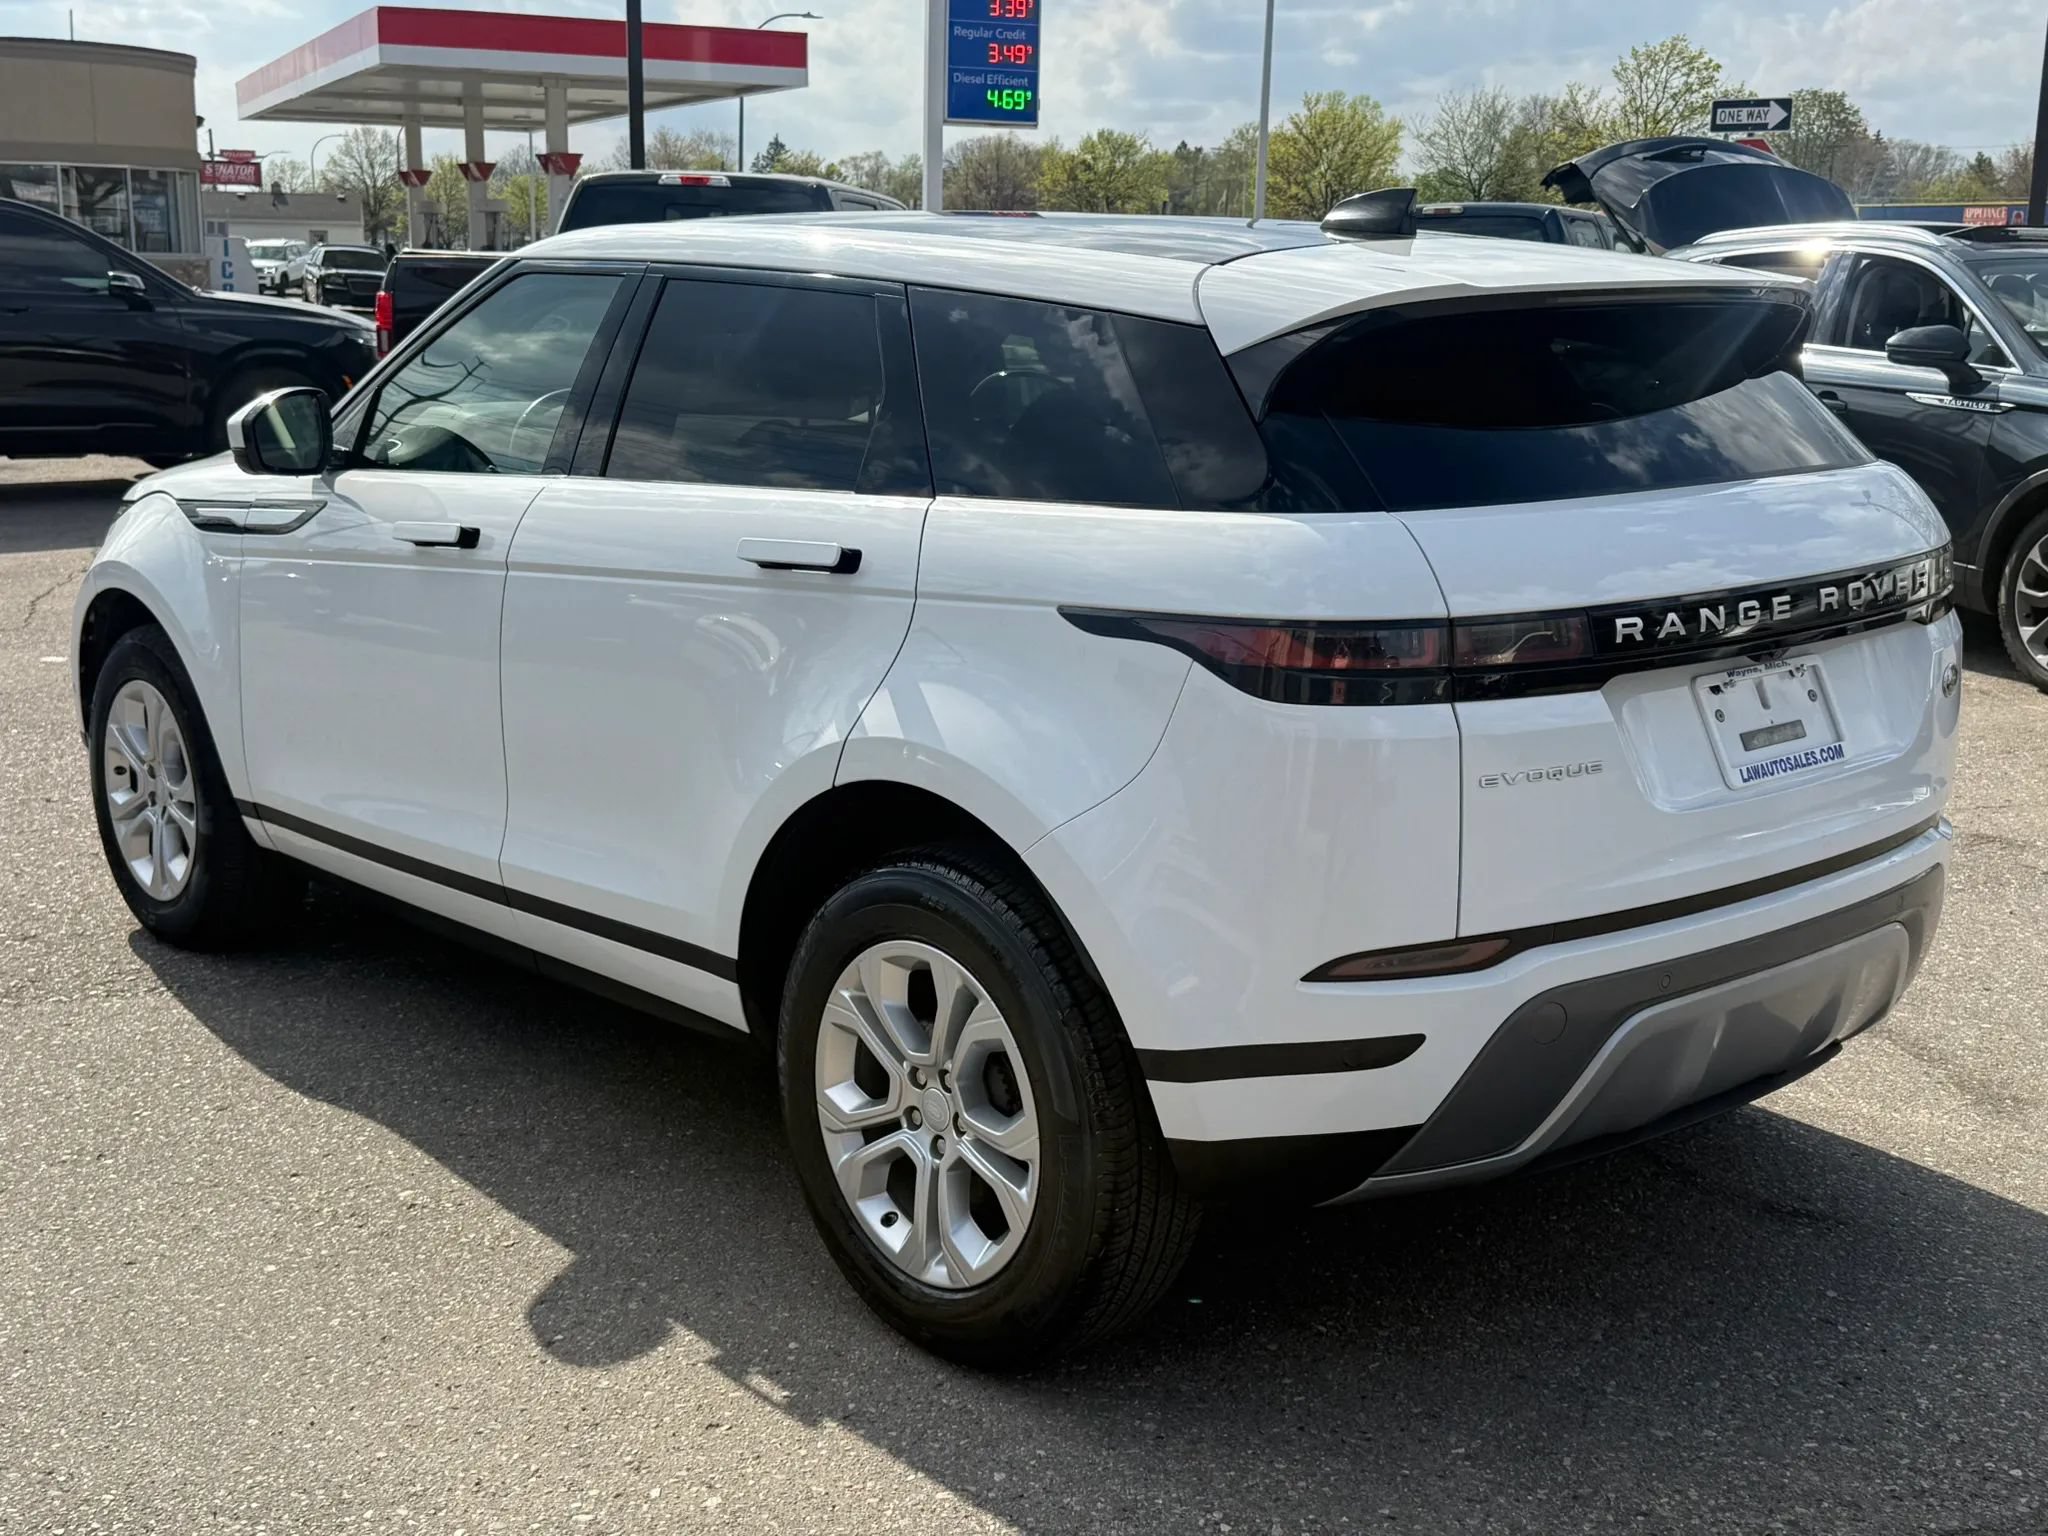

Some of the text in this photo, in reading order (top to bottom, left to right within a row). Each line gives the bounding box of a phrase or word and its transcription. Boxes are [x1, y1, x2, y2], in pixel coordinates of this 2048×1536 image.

[953, 26, 1026, 40] Regular Credit
[953, 72, 1028, 86] Diesel Efficient
[1719, 108, 1770, 122] ONE WAY
[204, 163, 256, 177] SENATOR
[1966, 207, 2007, 218] APPLIANCE
[1943, 400, 1991, 410] NAUTILUS
[1615, 563, 1930, 643] RANGE ROVER
[1726, 660, 1791, 678] Wayne, Mich.
[1739, 743, 1845, 783] LAWAUTOSALES.COM
[1479, 760, 1603, 788] EVOQUE
